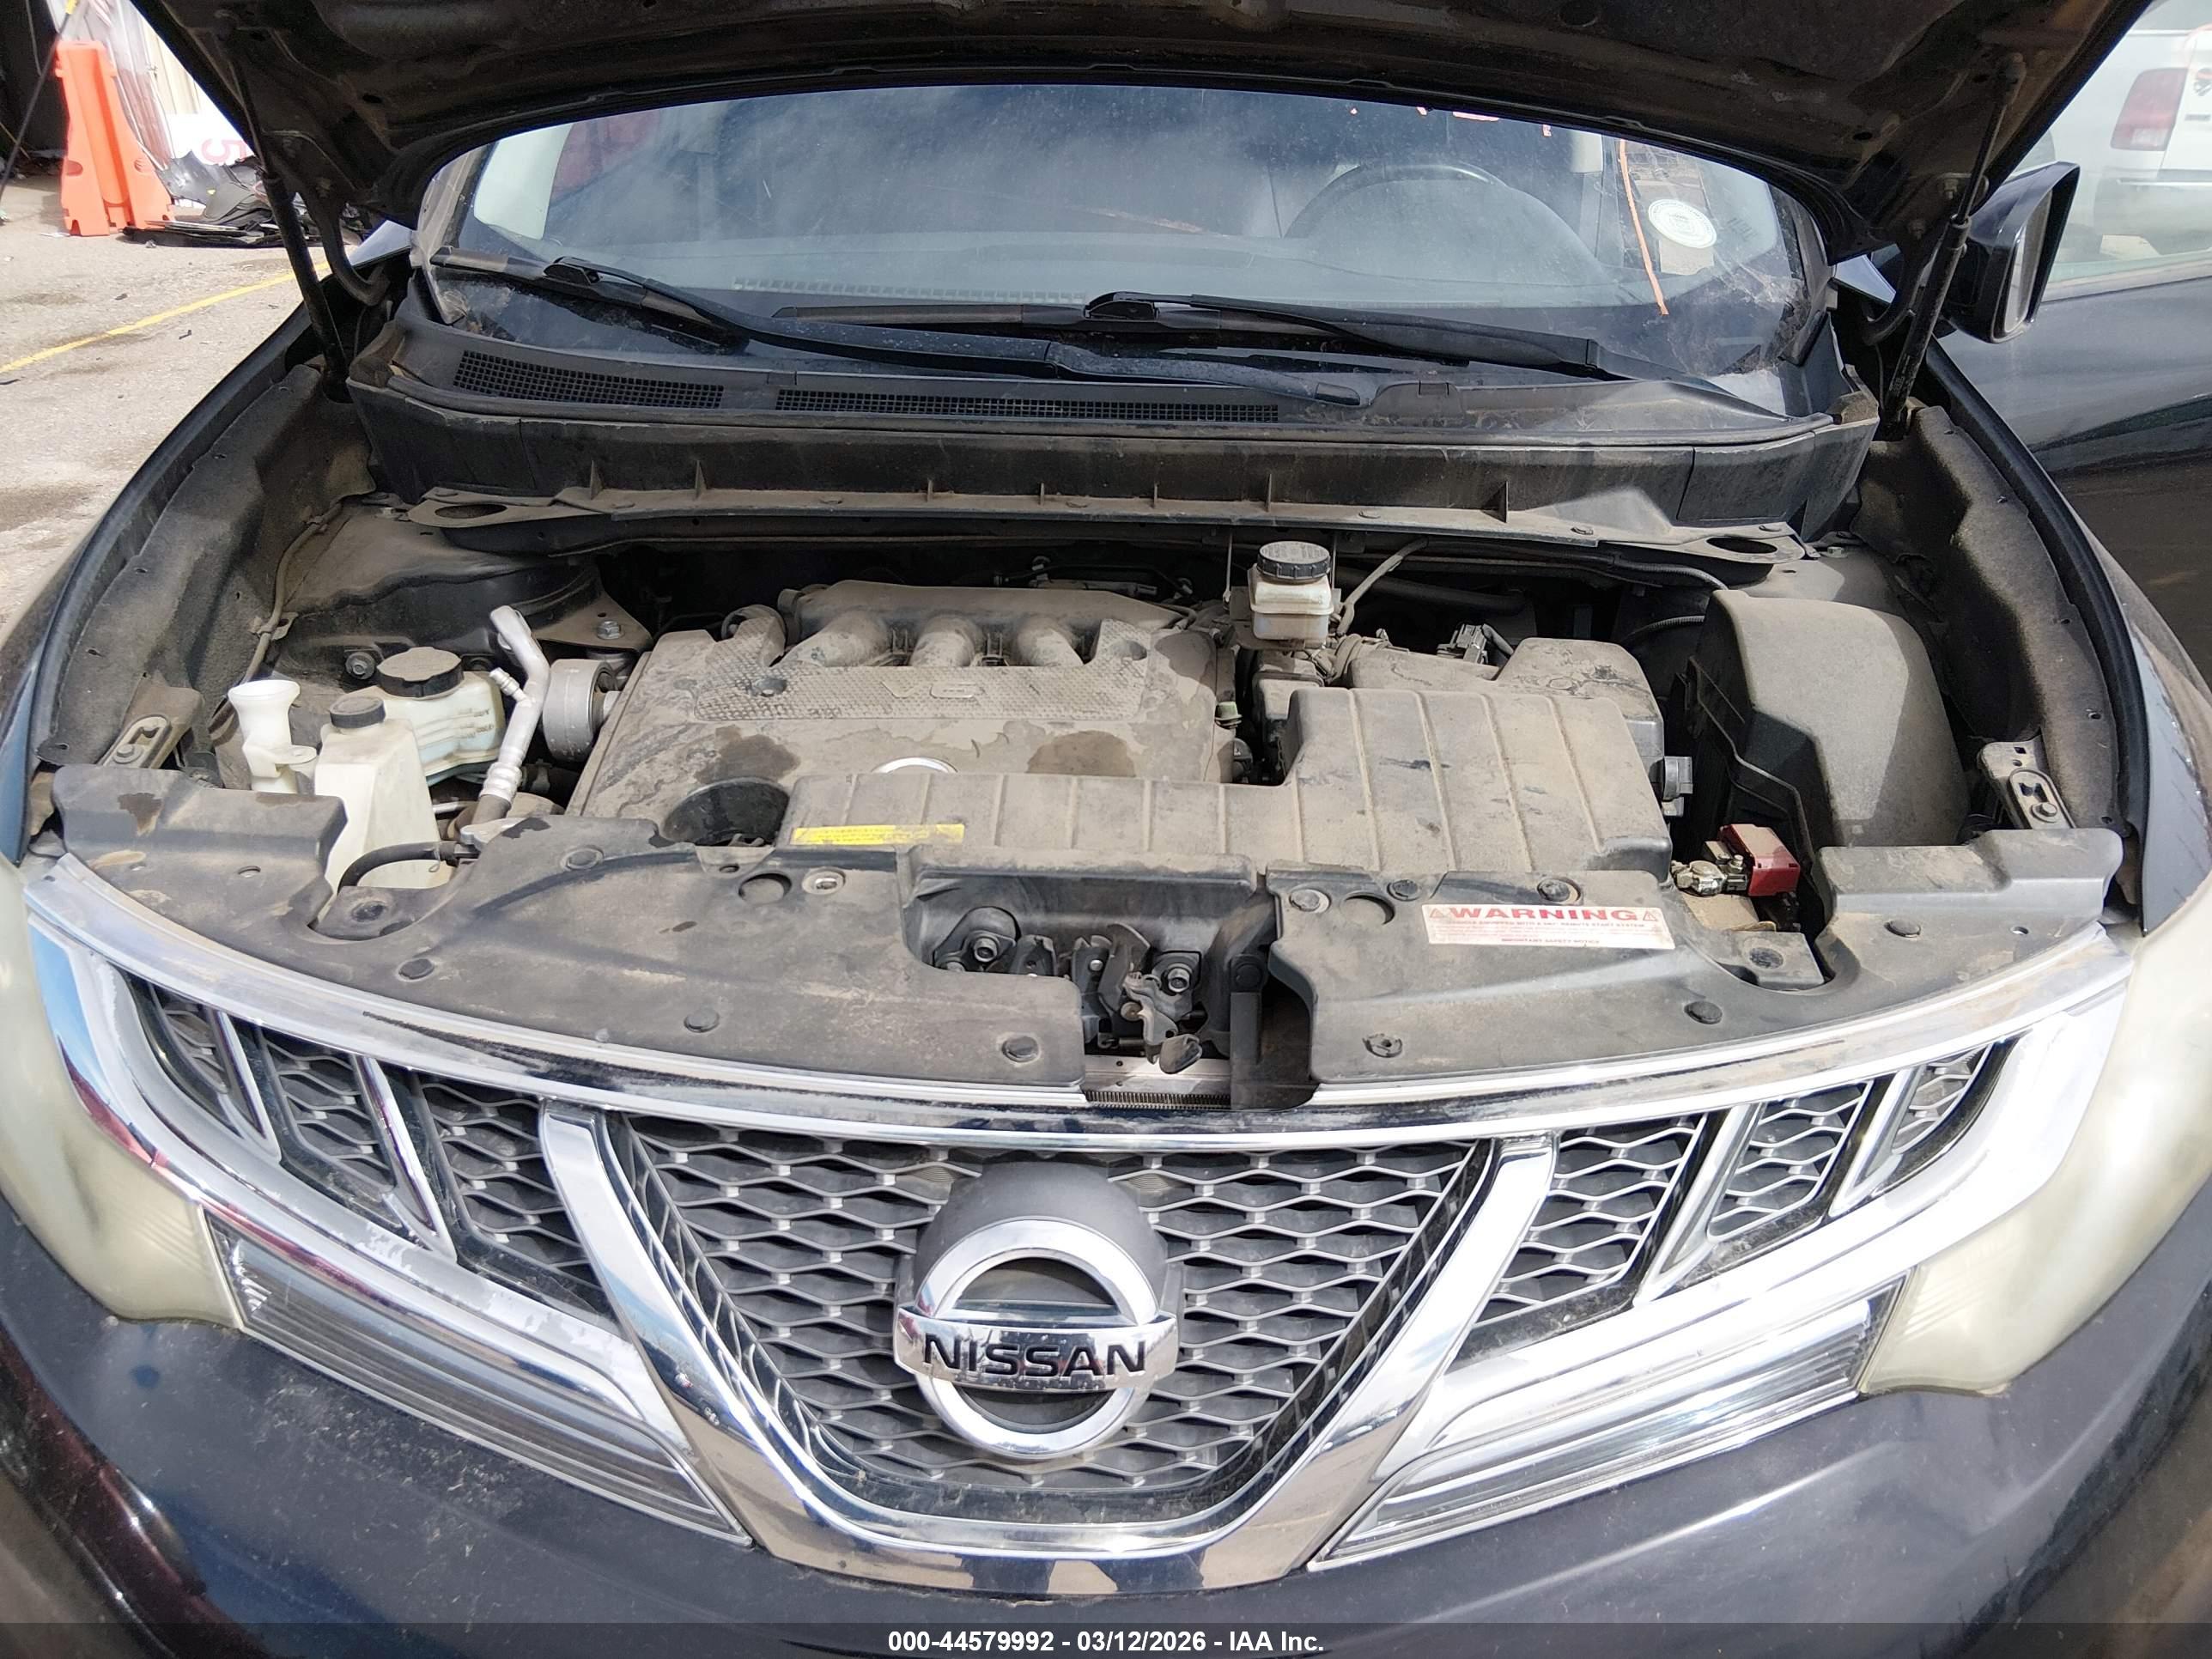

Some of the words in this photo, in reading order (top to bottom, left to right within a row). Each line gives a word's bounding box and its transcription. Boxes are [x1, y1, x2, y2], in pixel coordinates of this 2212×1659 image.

[878, 680, 980, 700] V6
[1449, 907, 1638, 921] WARNING
[923, 1333, 1146, 1378] NISSAN
